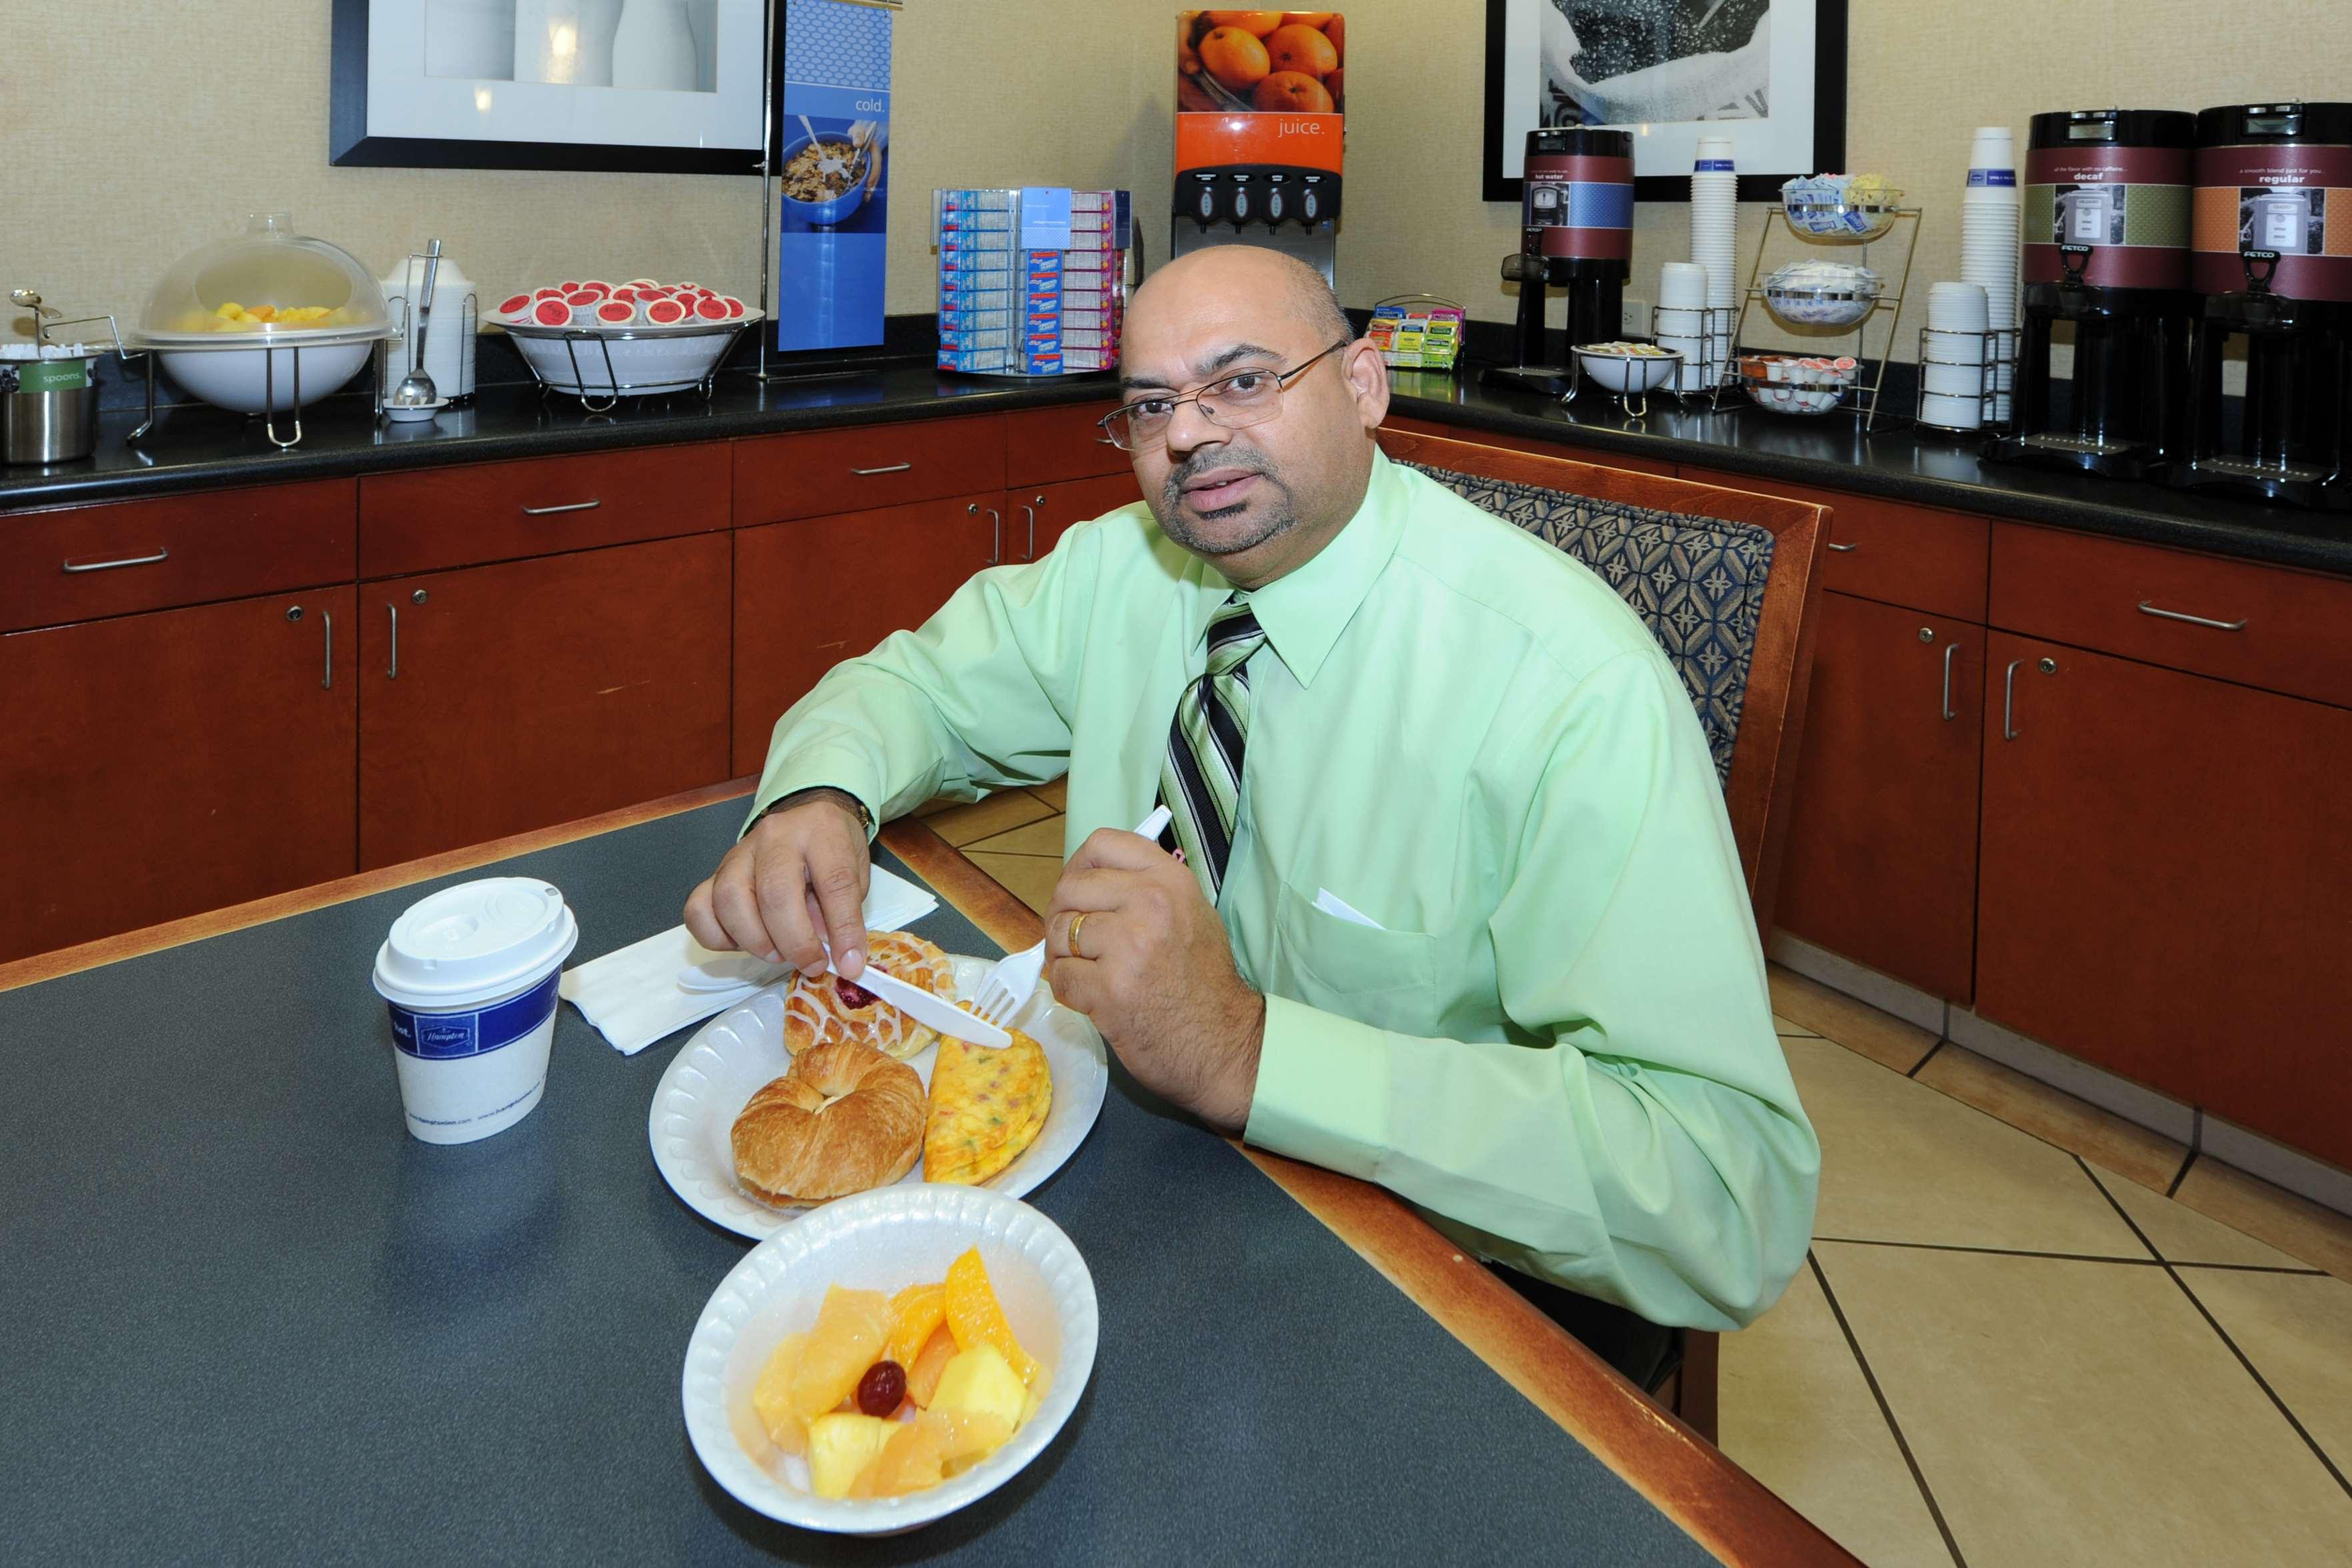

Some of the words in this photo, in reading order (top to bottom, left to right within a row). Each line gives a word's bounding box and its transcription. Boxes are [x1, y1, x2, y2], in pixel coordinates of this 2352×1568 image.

[855, 98, 885, 113] cold.
[1277, 118, 1325, 138] juice.
[2074, 172, 2103, 180] decaf
[2259, 175, 2305, 185] regular
[43, 372, 81, 383] spoons.
[427, 1032, 466, 1042] Hampton
